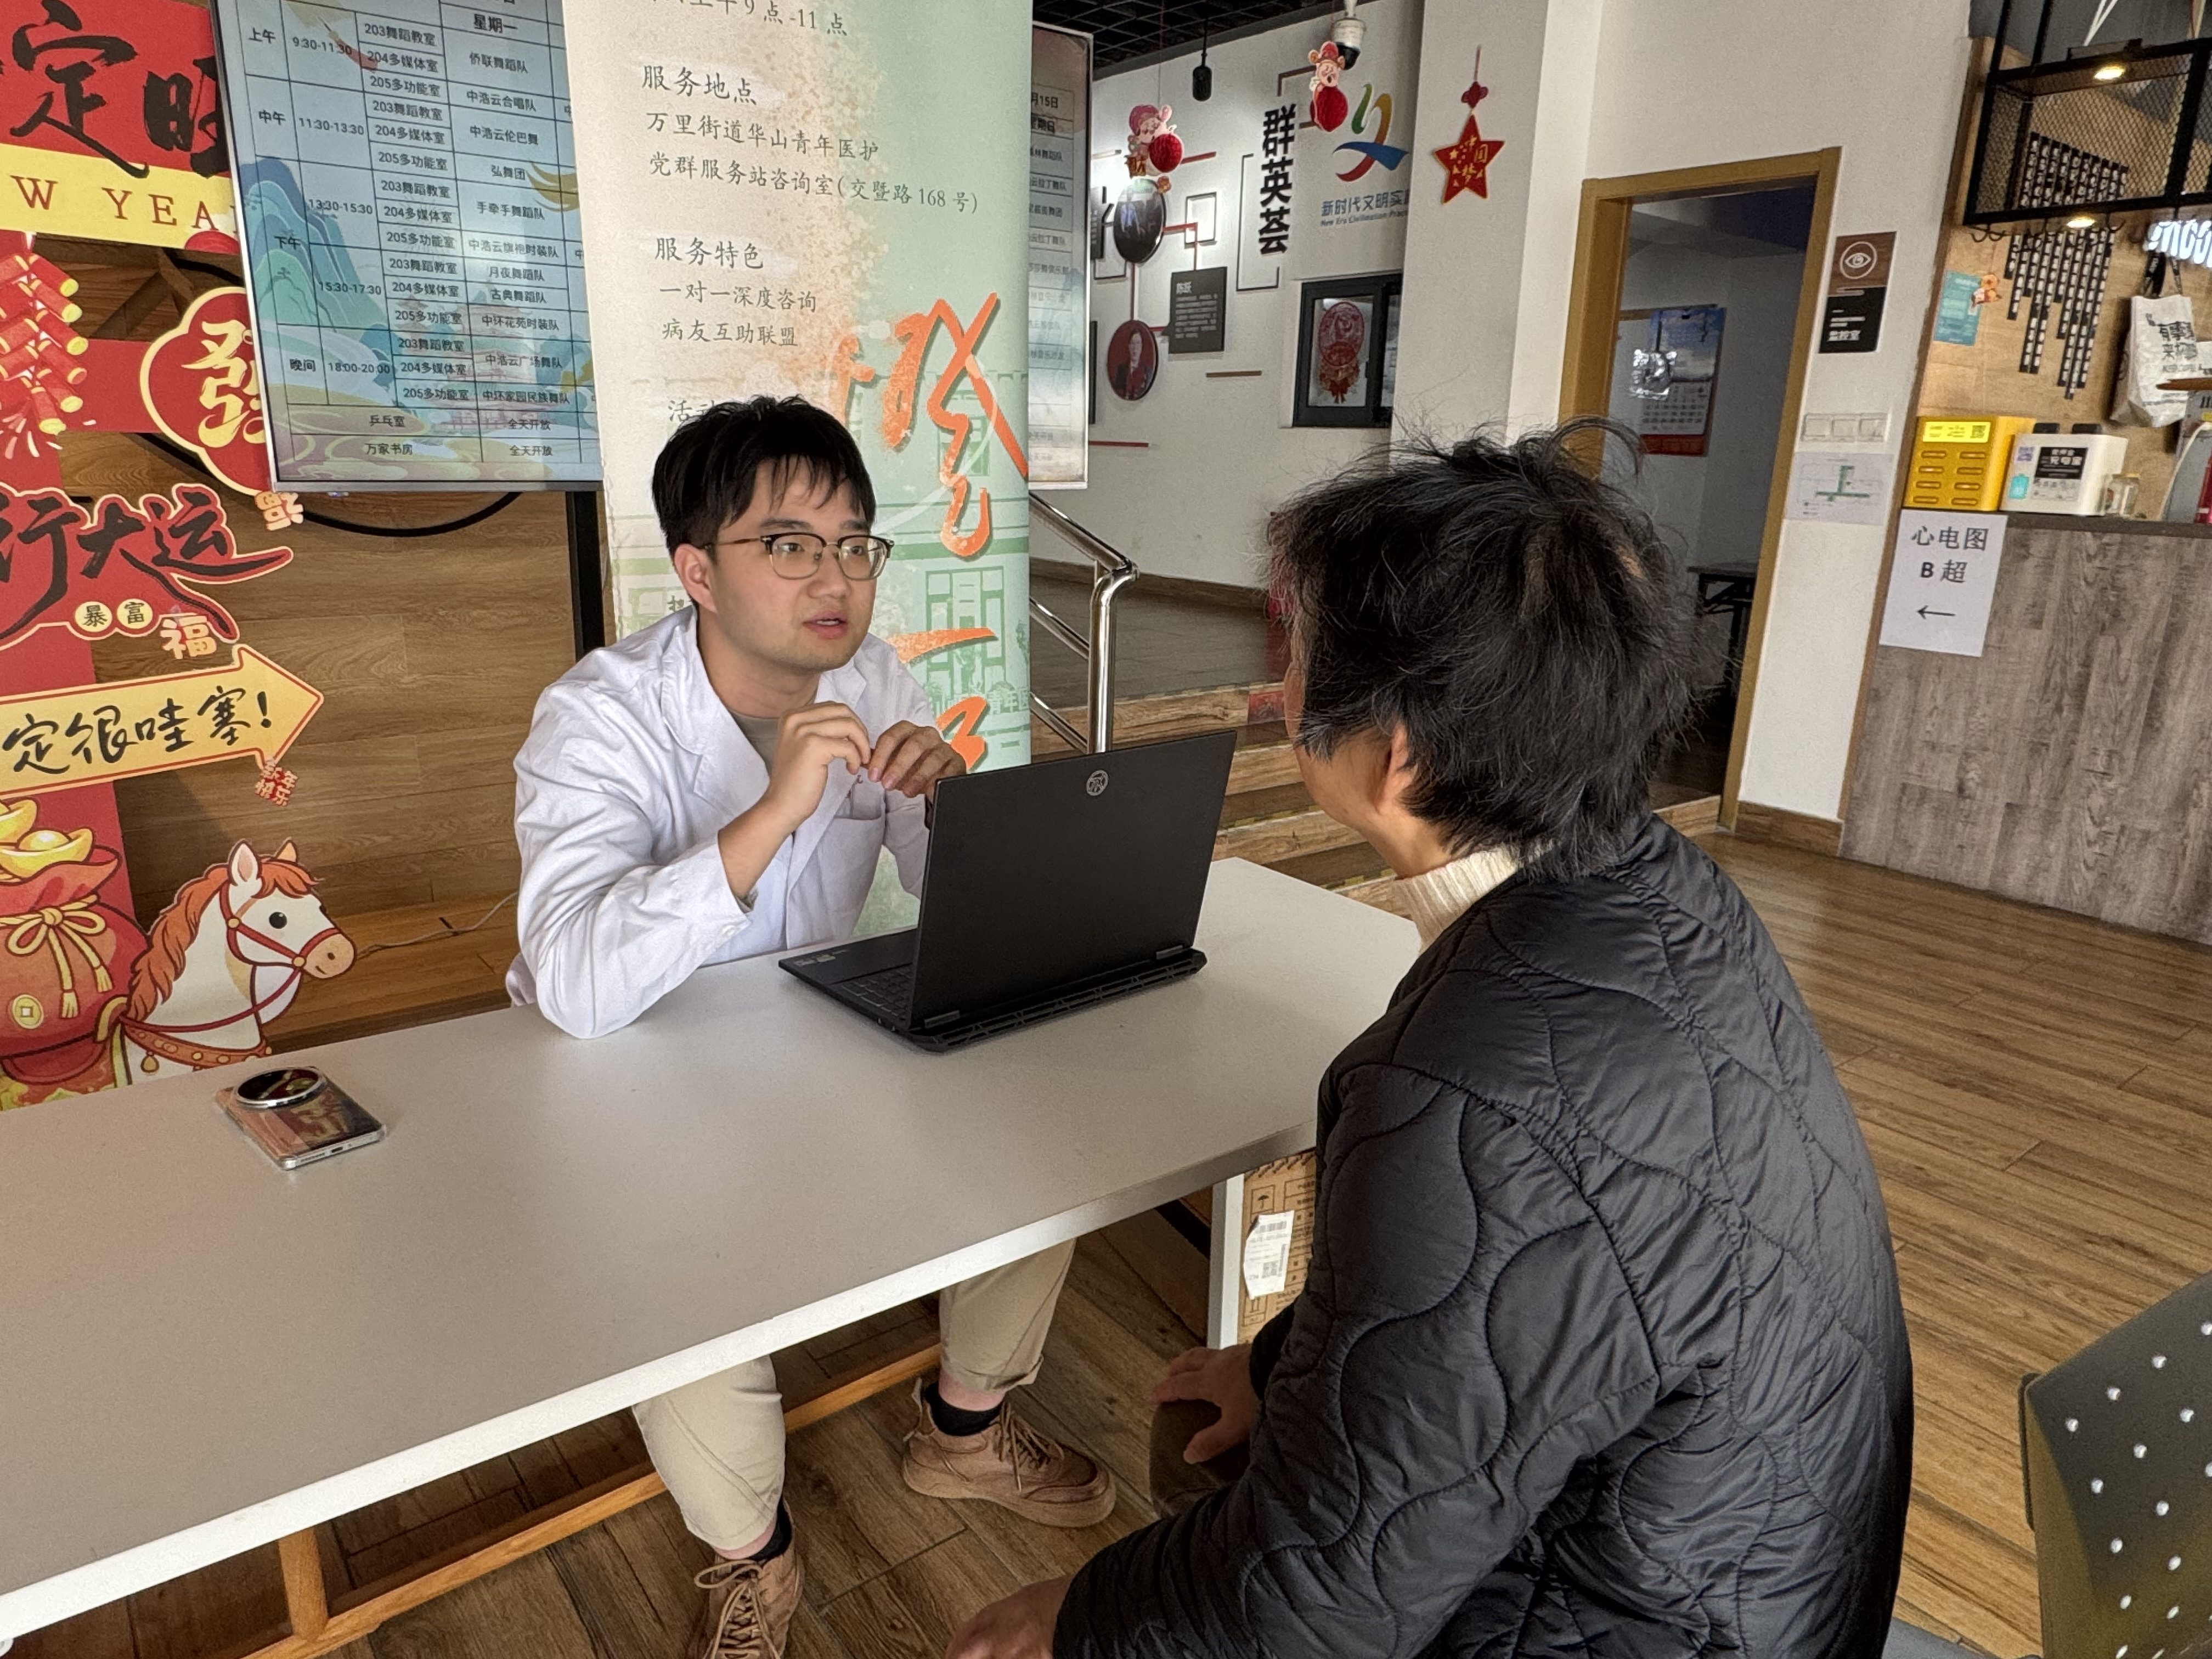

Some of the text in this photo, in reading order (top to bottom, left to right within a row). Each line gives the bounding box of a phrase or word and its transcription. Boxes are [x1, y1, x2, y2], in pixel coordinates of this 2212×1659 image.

[474, 13, 518, 33] 星期一
[249, 27, 276, 44] 上午
[364, 23, 436, 46] 203舞蹈教室
[368, 51, 438, 72] 204多媒体室
[370, 75, 441, 97] 205多功能室
[642, 65, 757, 105] 服务地点
[258, 110, 285, 125] 中午
[372, 100, 443, 121] 203舞蹈教室
[299, 117, 364, 135] 11:30-13:30
[375, 125, 445, 144] 204多媒体室
[646, 112, 879, 161] 万里街道华山青年医护
[378, 151, 448, 170] 205多功能室
[1258, 103, 1296, 255] 群英荟
[381, 180, 450, 198] 203舞蹈教室
[102, 187, 238, 234] YEA
[308, 199, 373, 215] 13:30-15:30
[1321, 189, 1410, 216] 新时代文明实
[383, 206, 452, 223] 204多媒体室
[274, 236, 301, 250] 下午
[386, 232, 456, 249] 205多功能室
[654, 237, 763, 269] 服务特色
[390, 258, 458, 274] 203舞蹈教室
[319, 282, 382, 295] 15:30-17:30
[392, 281, 459, 297] 204多媒体室
[659, 280, 816, 312] 一对一深度咨询
[395, 310, 462, 324] 205多功能室
[662, 319, 798, 347] 病友互助联盟
[398, 338, 465, 352] 203舞蹈教室
[290, 359, 316, 371] 晚间
[329, 362, 390, 374] 18:00-20:00
[400, 362, 466, 375] 204多媒体室
[403, 388, 469, 400] 205多功能室
[369, 415, 405, 427] 乒乓室
[509, 419, 551, 430] 全天开放
[365, 443, 413, 455] 万家书房
[510, 445, 553, 456] 全天开放
[1910, 526, 1989, 551] 心电图
[1920, 559, 1968, 583] B 超
[83, 601, 145, 628] 暴富
[160, 615, 217, 659] 福
